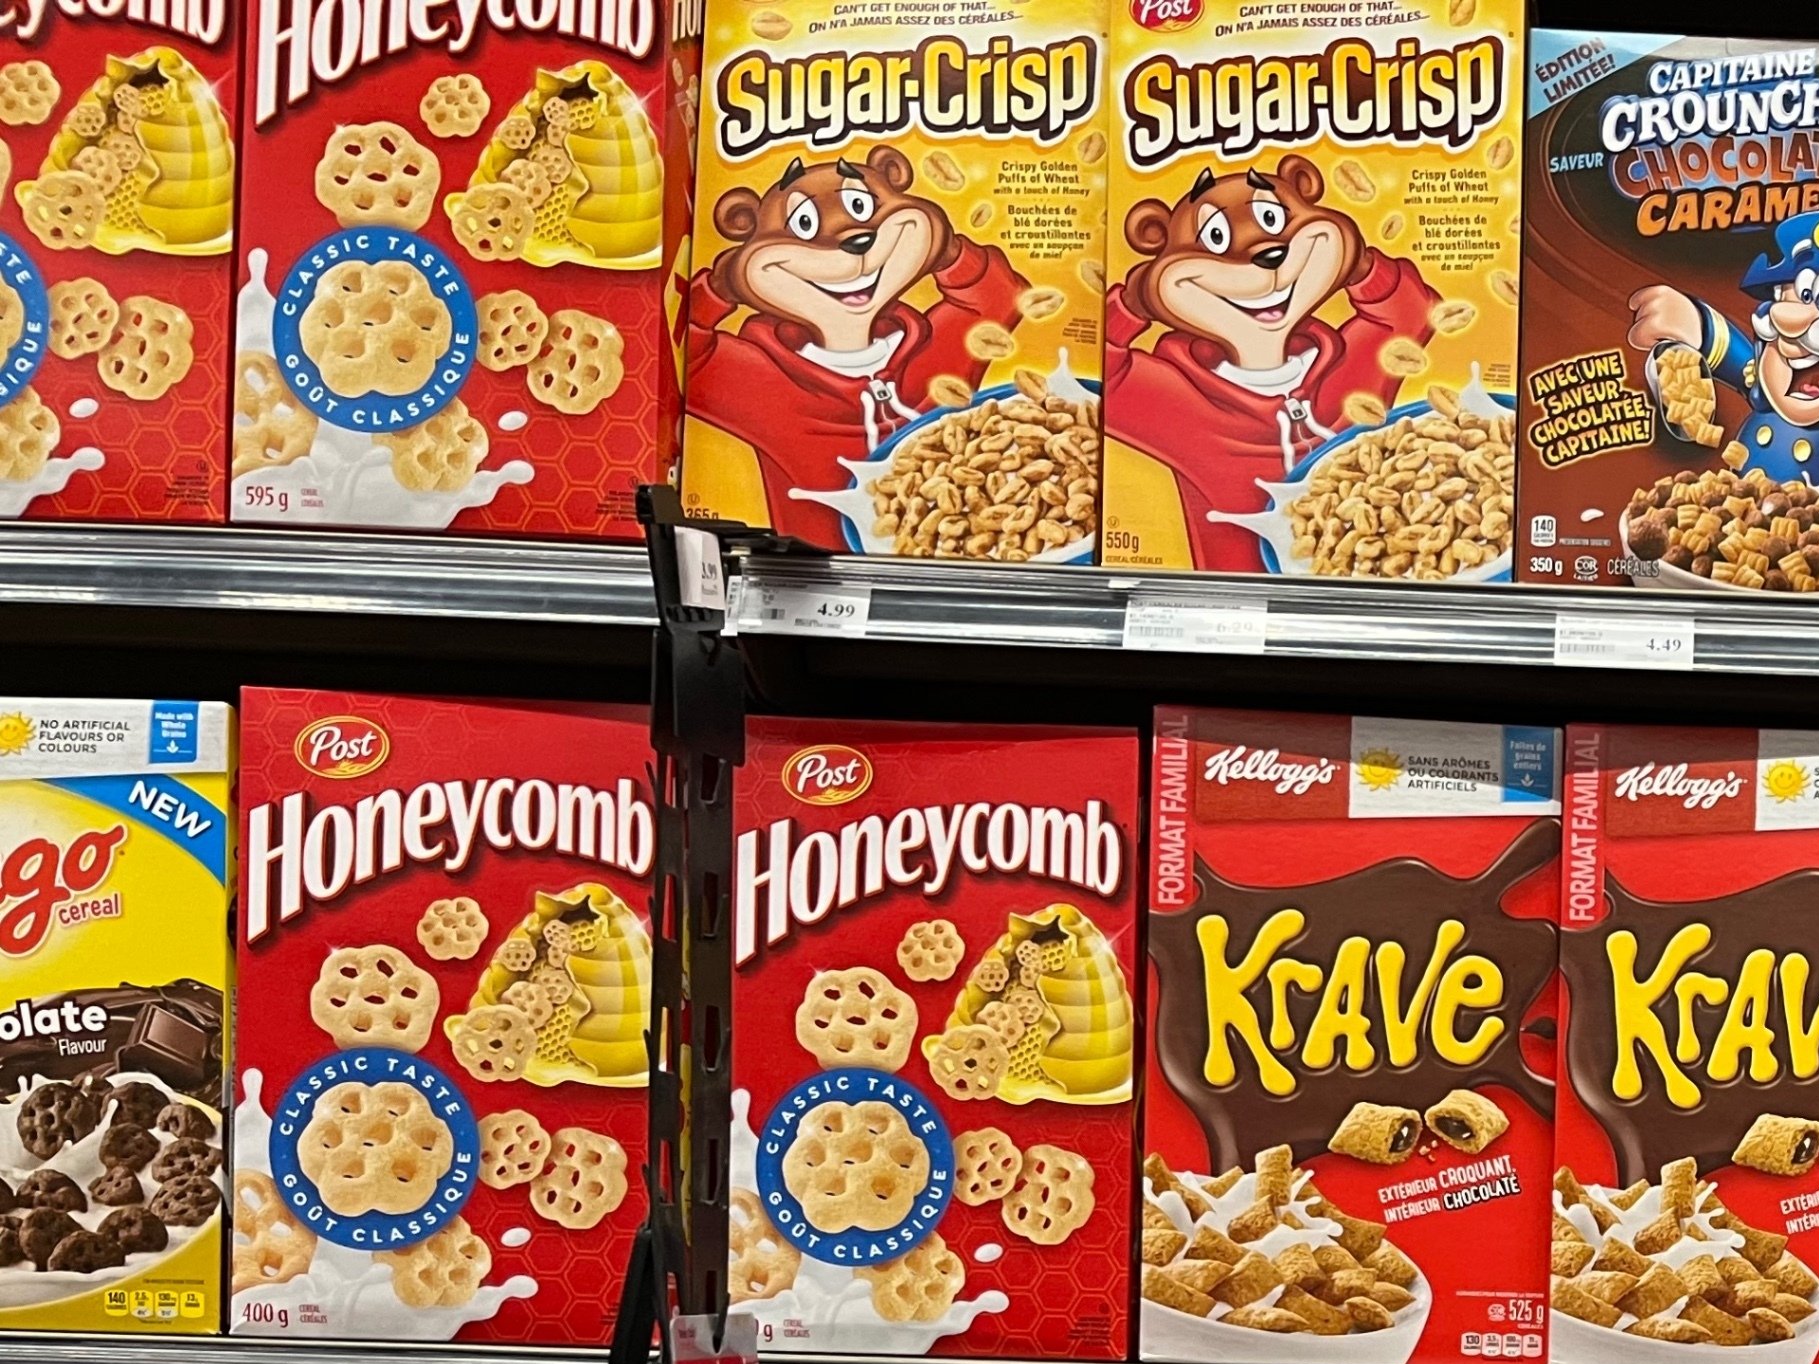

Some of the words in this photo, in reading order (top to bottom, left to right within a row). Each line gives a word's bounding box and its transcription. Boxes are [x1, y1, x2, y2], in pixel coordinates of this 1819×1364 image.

[1240, 4, 1271, 17] CAN'T
[1276, 4, 1296, 15] GET
[1300, 3, 1346, 14] ENOUGH
[1349, 2, 1363, 12] OF
[1535, 37, 1606, 83] ÉDITION
[1543, 54, 1615, 103] LIMITÉE!
[1649, 49, 1815, 94] CAPITAINE
[726, 39, 1086, 148] Sugar-Crisp
[1133, 41, 1496, 158] Sugar-Crisp
[1550, 153, 1603, 173] SAVEUR
[1534, 366, 1578, 396] AVEC
[1581, 353, 1621, 389] UNE
[1548, 381, 1620, 416] SAVEUR
[1546, 419, 1650, 463] CAPITAINE!
[245, 486, 272, 506] 595
[278, 490, 289, 512] g
[817, 602, 855, 618] 4.99
[1646, 638, 1681, 652] 4.49
[39, 731, 103, 742] FLAVOURS
[107, 733, 124, 742] OR
[41, 720, 58, 729] NO
[63, 720, 129, 730] ARTIFICIAL
[310, 726, 377, 766] Post
[39, 743, 97, 753] COLOURS
[1160, 715, 1188, 814] FAMILIAL
[796, 755, 861, 792] Post
[1205, 746, 1335, 794] Kellogg's
[1615, 762, 1741, 809] Kellogg's
[128, 780, 211, 838] NEW
[247, 779, 654, 942] Honeycomb
[1158, 817, 1186, 904] FORMAT
[735, 801, 1121, 965] Honeycomb
[59, 894, 119, 923] cereal
